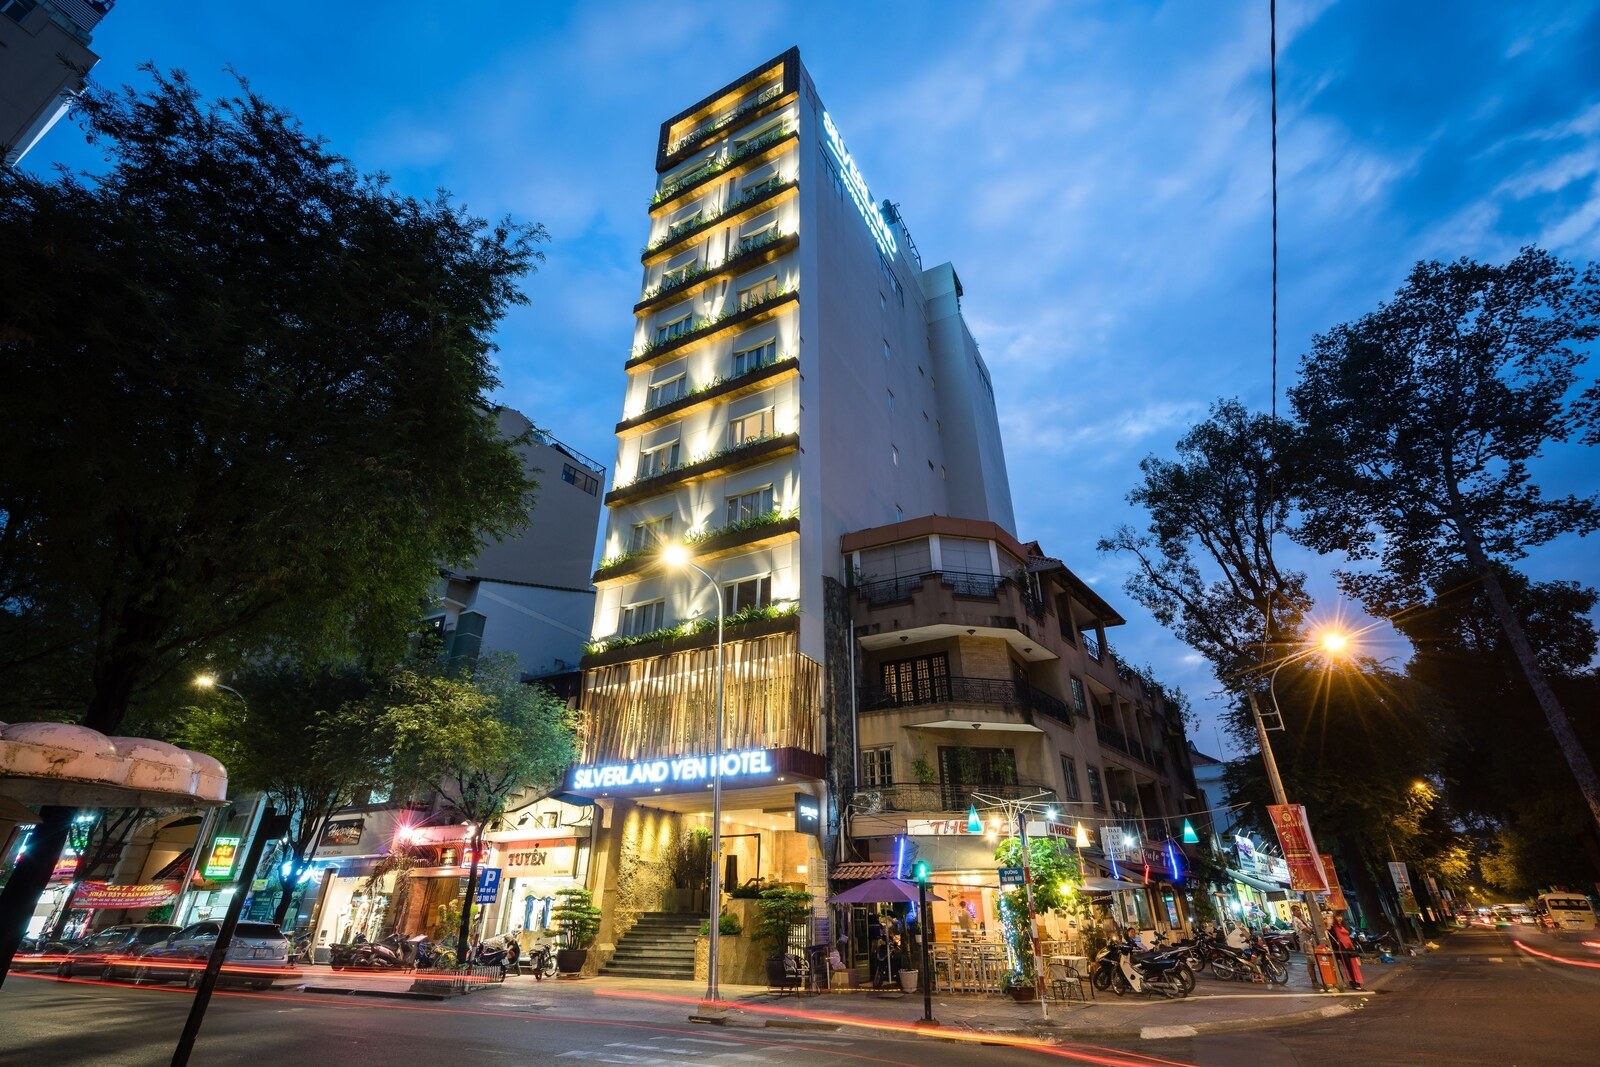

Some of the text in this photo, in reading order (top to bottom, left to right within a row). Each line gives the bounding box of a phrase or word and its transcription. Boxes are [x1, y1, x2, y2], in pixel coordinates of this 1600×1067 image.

[573, 750, 772, 790] SILVERLAND YEN HOTEL
[484, 870, 497, 887] P
